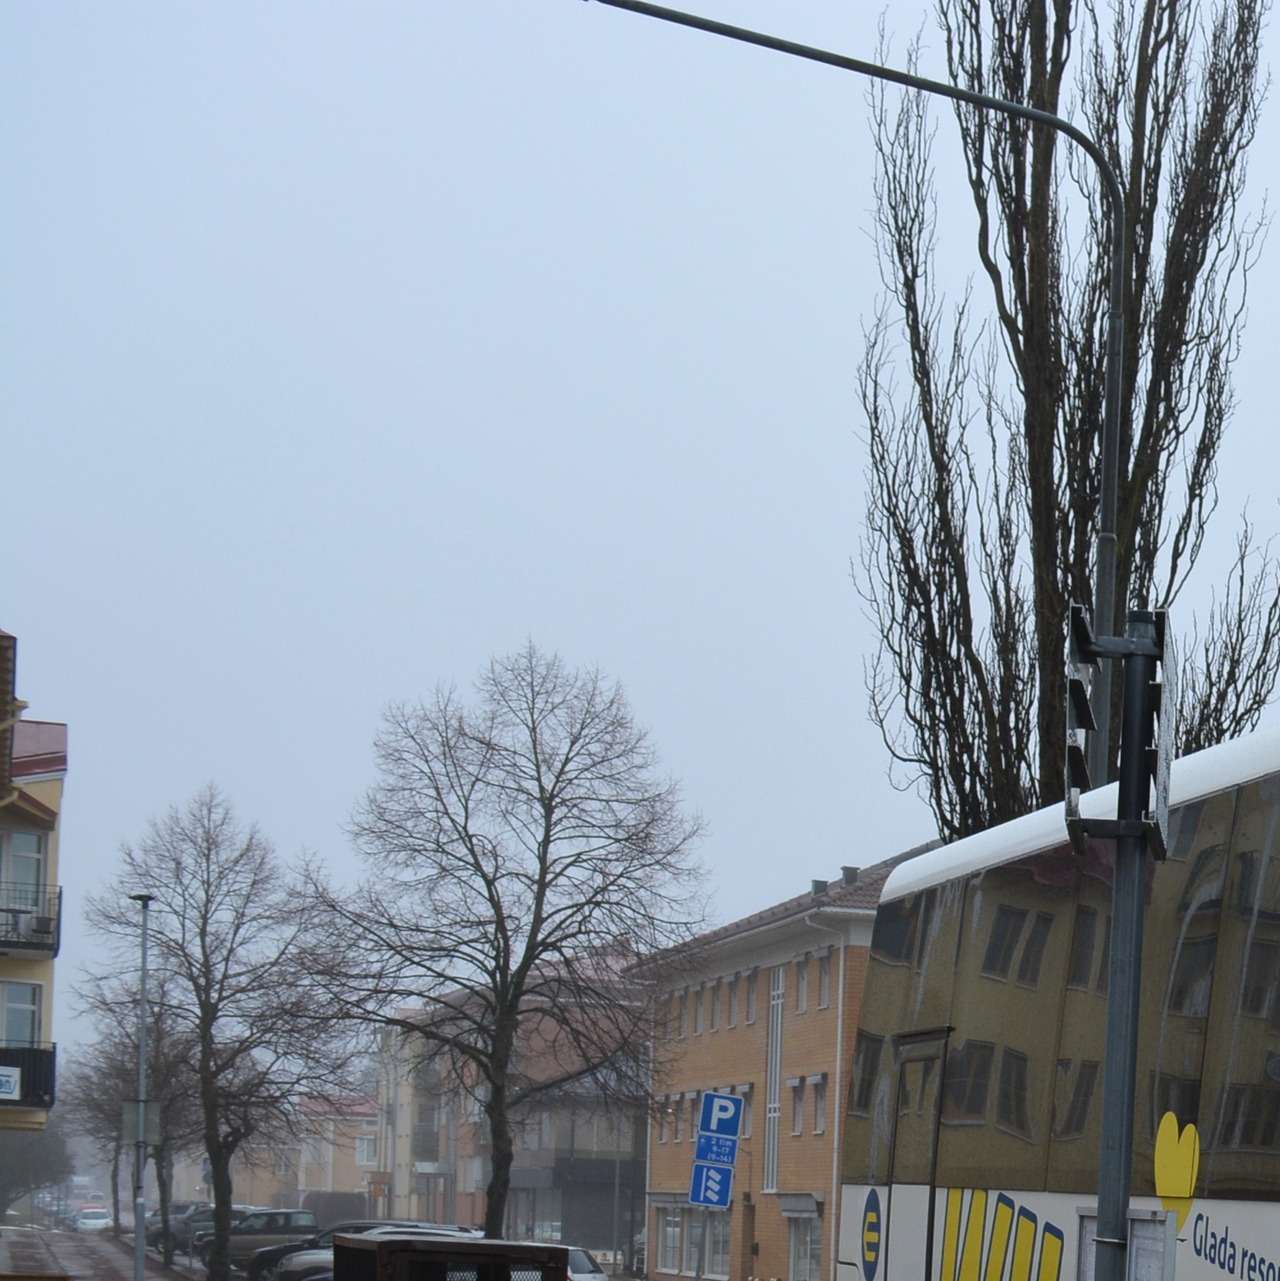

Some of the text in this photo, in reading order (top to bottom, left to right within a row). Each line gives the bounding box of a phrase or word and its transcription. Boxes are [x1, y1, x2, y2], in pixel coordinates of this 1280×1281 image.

[710, 1097, 735, 1131] P
[710, 1137, 732, 1147] 2 tim
[712, 1145, 730, 1154] 9-17
[707, 1152, 732, 1163] (9-14)
[1193, 1213, 1236, 1275] Glada
